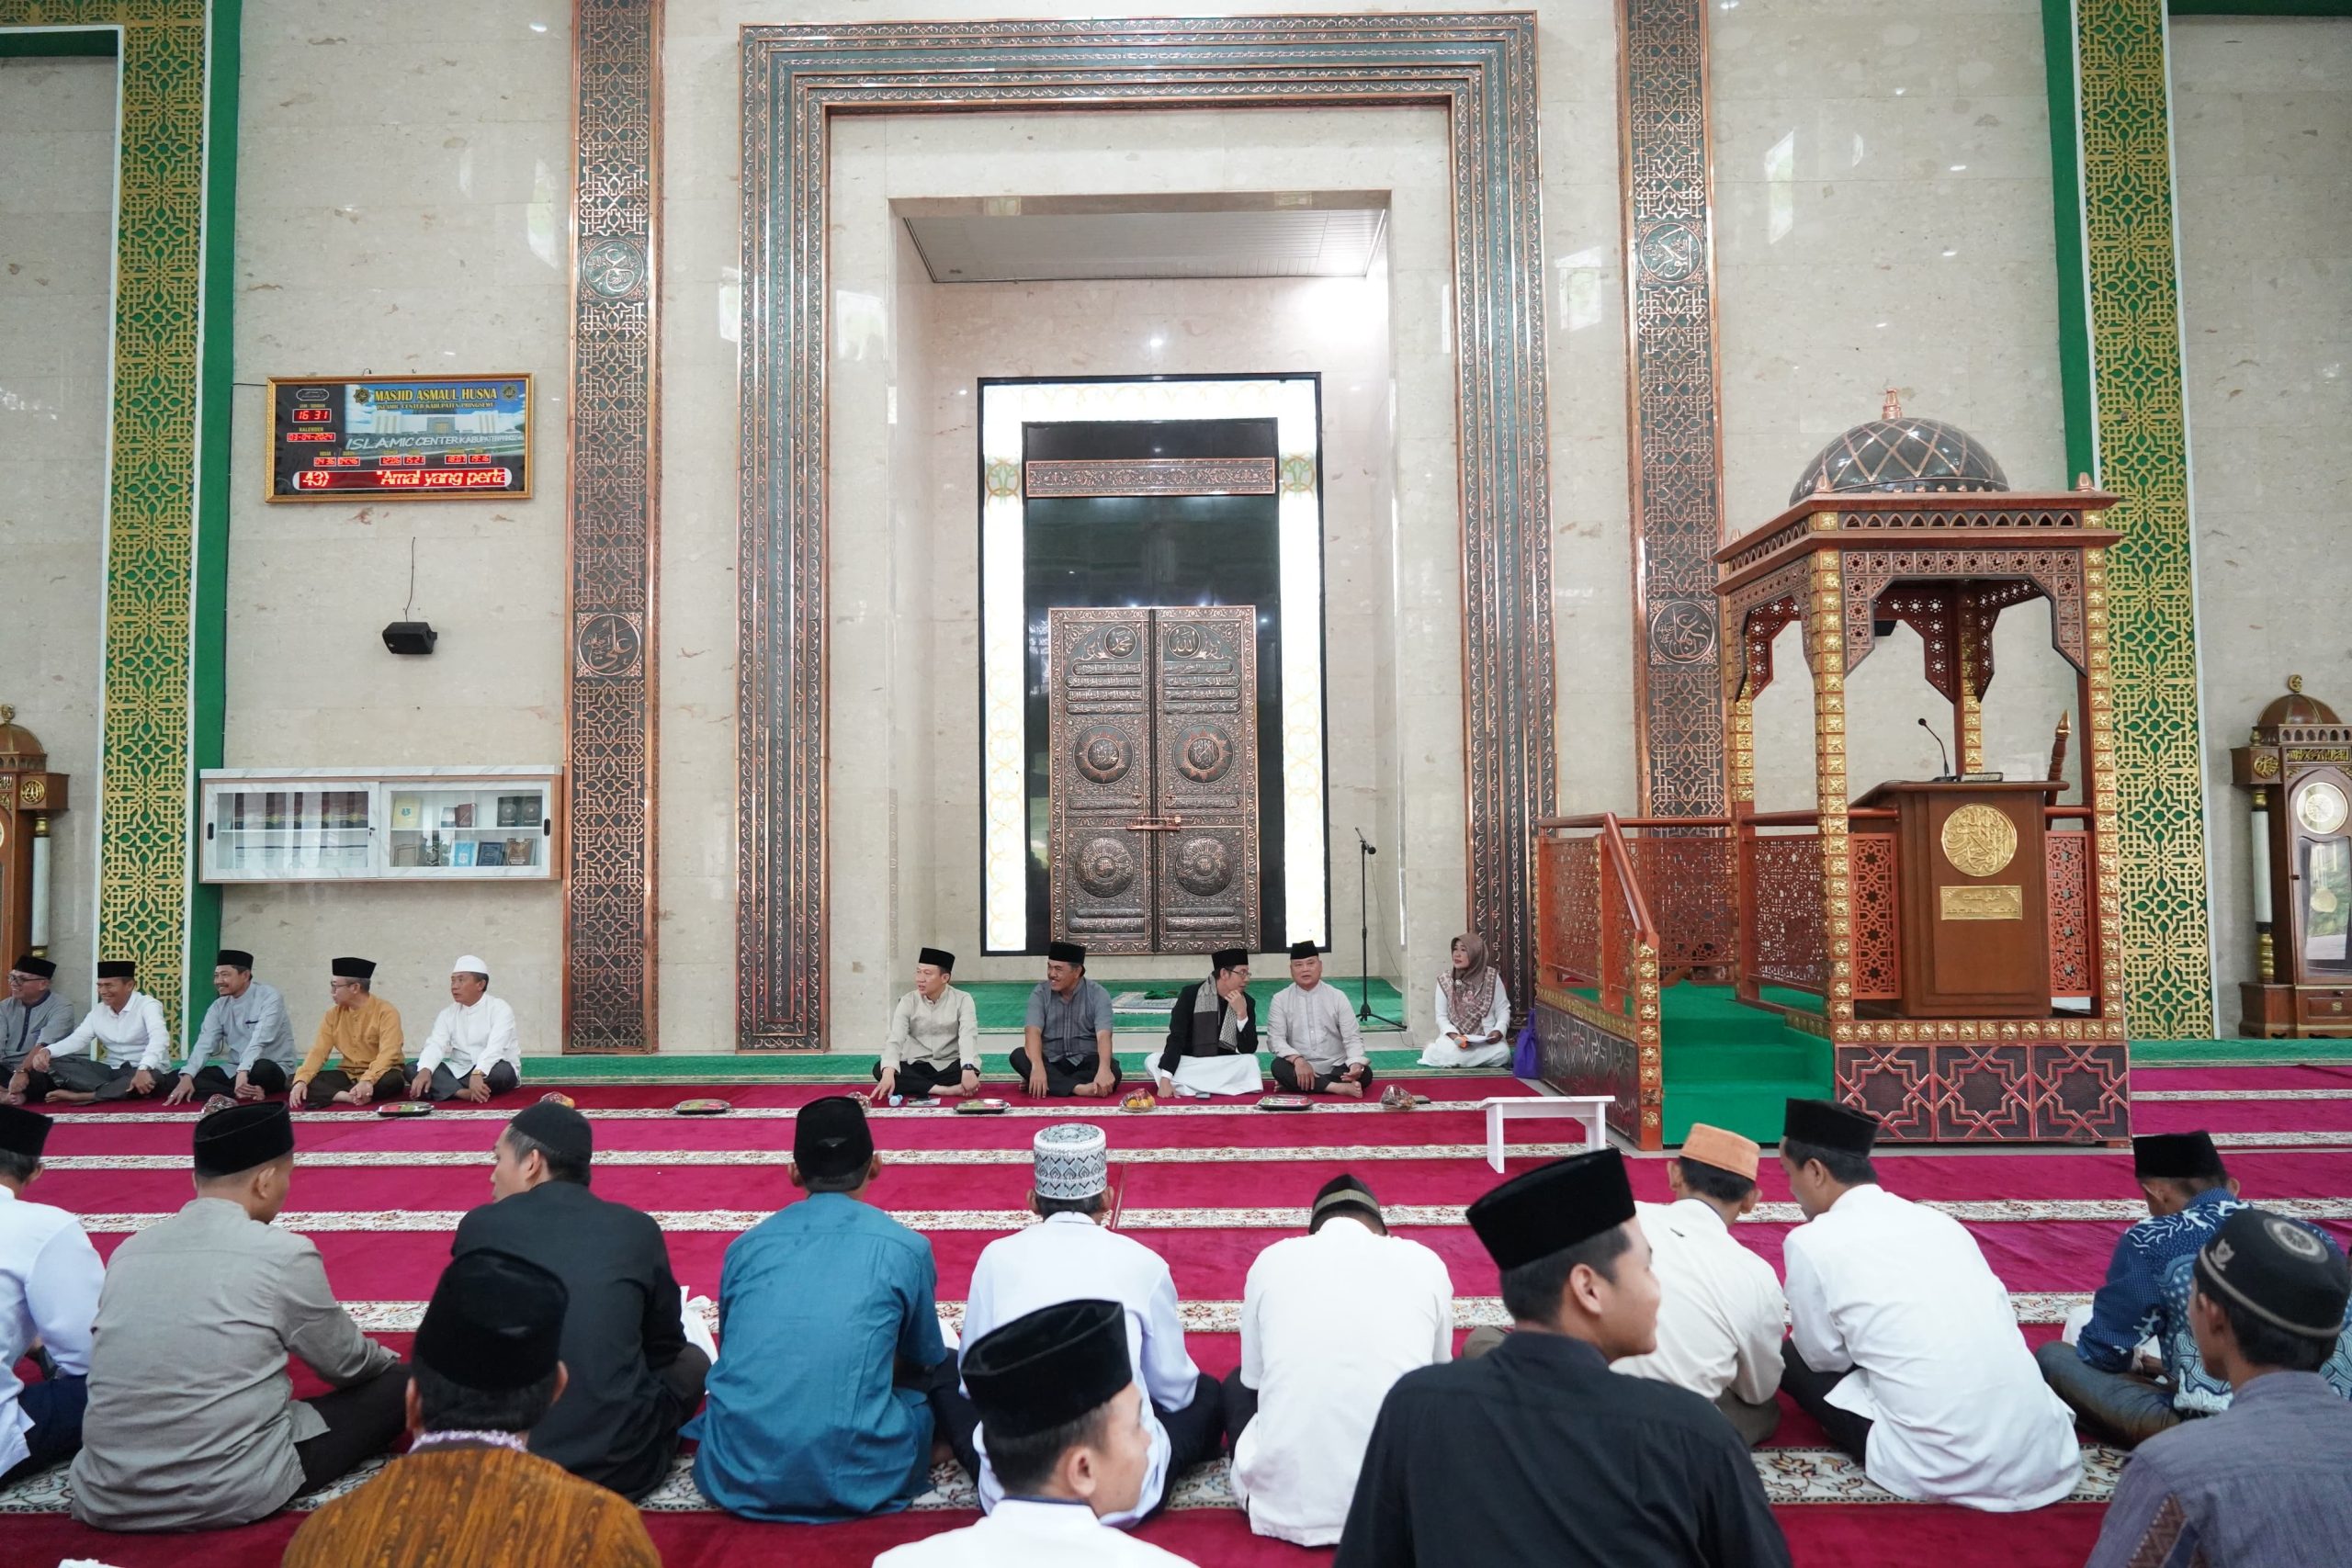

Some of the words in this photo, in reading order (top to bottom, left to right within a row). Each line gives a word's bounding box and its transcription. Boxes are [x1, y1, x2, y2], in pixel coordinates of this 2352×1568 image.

[375, 389, 413, 402] MASJID
[417, 389, 458, 401] ASMAUL
[461, 388, 498, 400] HUSNA
[345, 437, 415, 450] ISLAMIC
[415, 435, 458, 446] CENTER
[424, 472, 464, 487] yang
